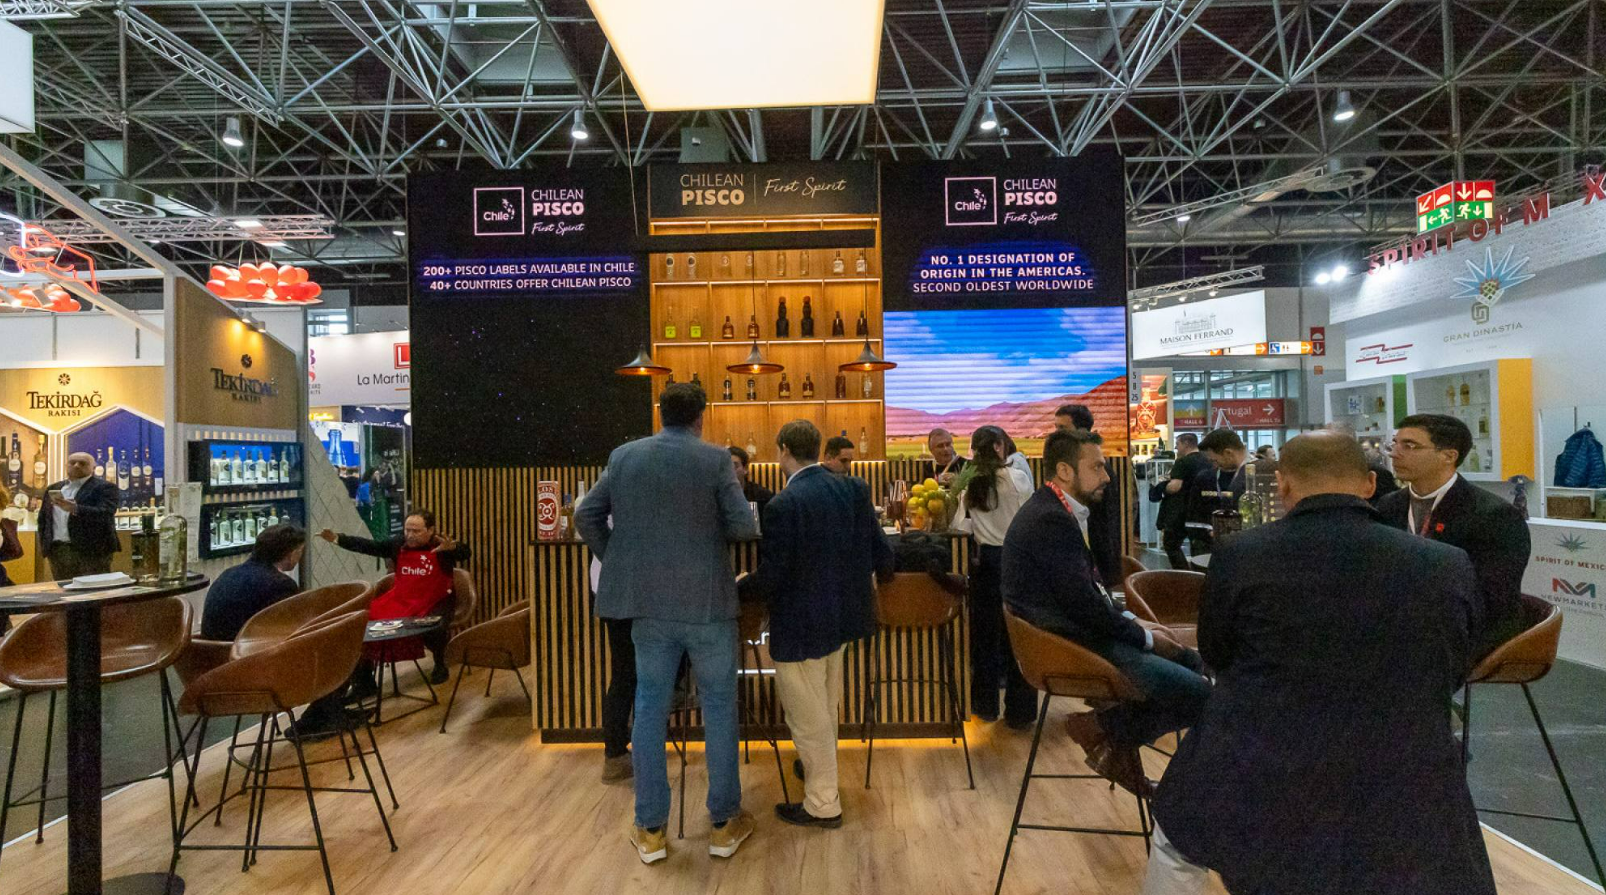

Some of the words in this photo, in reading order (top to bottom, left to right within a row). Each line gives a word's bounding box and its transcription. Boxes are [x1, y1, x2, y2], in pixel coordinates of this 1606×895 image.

[680, 173, 744, 188] CHILEAN
[764, 178, 800, 197] First
[801, 176, 847, 198] Spirit
[1003, 178, 1057, 190] CHILEAN
[531, 189, 584, 201] CHILEAN
[681, 189, 745, 206] PISCO
[1004, 191, 1058, 206] PISCO
[532, 202, 585, 216] PISCO
[954, 200, 982, 212] Chile
[483, 210, 509, 222] Chile
[1003, 212, 1027, 225] First
[1028, 210, 1059, 226] Spirit
[531, 222, 555, 235] First
[555, 221, 586, 236] Spirit
[1367, 222, 1458, 276] SPIRIT
[1469, 203, 1511, 242] OF
[931, 255, 953, 266] NO.
[957, 255, 963, 265] 1
[967, 252, 1054, 265] DESIGNATION
[1058, 252, 1075, 263] OF
[423, 265, 452, 276] 200+
[455, 264, 487, 276] PISCO
[489, 263, 527, 275] LABELS
[529, 262, 587, 274] AVAILABLE
[589, 262, 602, 273] IN
[604, 261, 635, 273] CHILE
[920, 268, 967, 280] ORIGIN
[970, 267, 985, 279] IN
[989, 266, 1013, 278] THE
[1017, 265, 1086, 278] AMERICAS.
[429, 280, 452, 291] 40+
[454, 278, 513, 291] COUNTRIES
[515, 278, 549, 290] OFFER
[551, 277, 597, 289] CHILEAN
[598, 276, 632, 288] PISCO
[913, 281, 962, 293] SECOND
[965, 280, 1011, 292] OLDEST
[1015, 279, 1095, 291] WORLDWIDE
[1160, 333, 1192, 345] MAISON
[1194, 327, 1234, 341] FERRAND
[1443, 332, 1471, 344] GRAN
[357, 373, 371, 386] La
[372, 372, 411, 385] Martin
[1132, 371, 1137, 380] 5
[26, 390, 103, 410] TEKİRDAĞ
[1131, 393, 1139, 402] 25
[48, 409, 81, 417] RAKISI
[1535, 556, 1561, 564] SPIRIT
[401, 566, 427, 576] Chile
